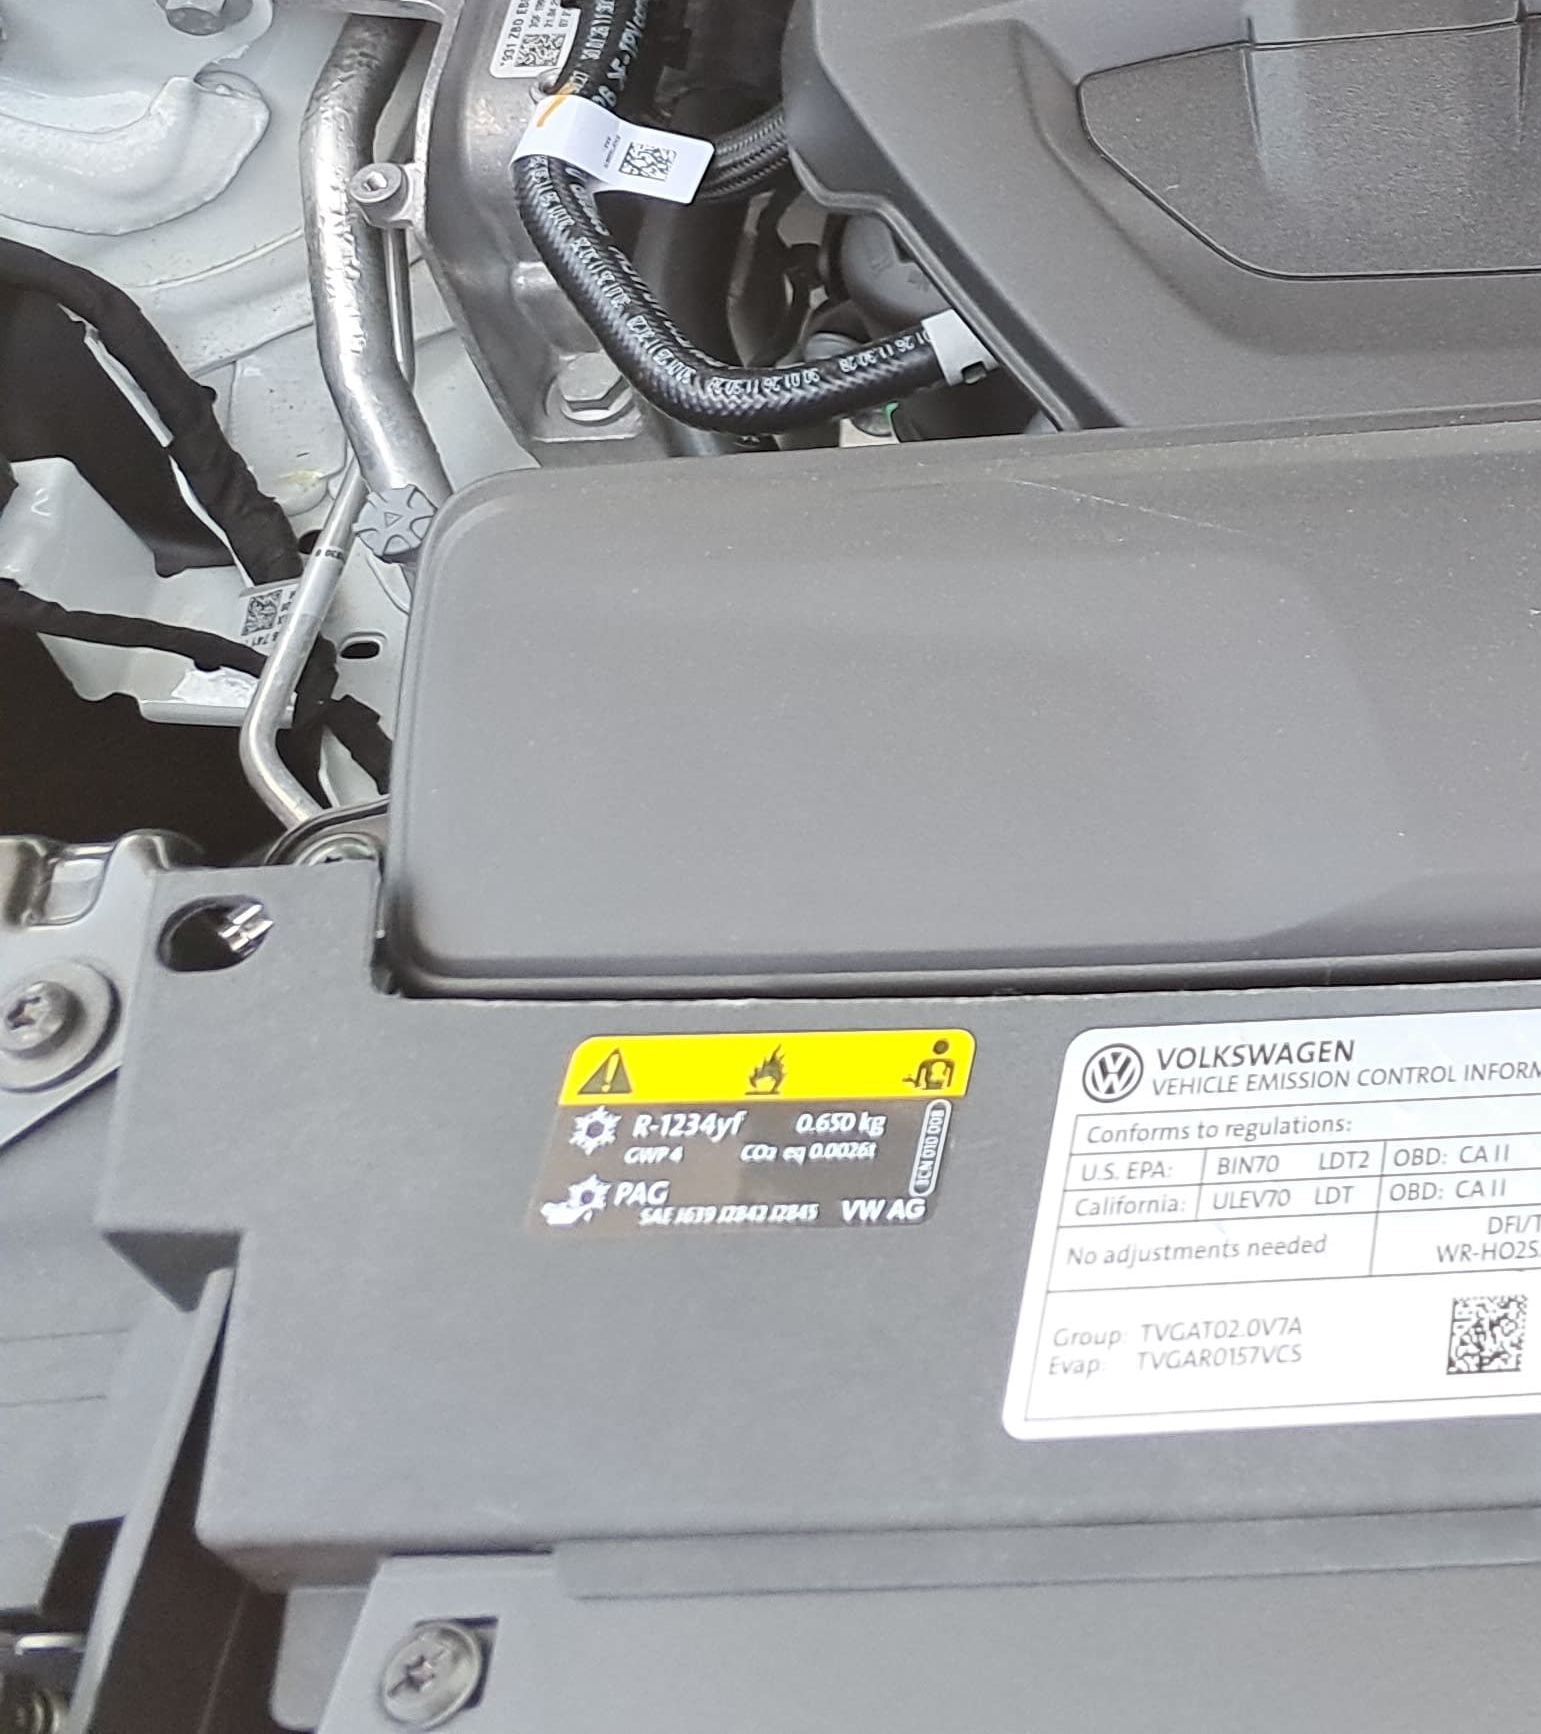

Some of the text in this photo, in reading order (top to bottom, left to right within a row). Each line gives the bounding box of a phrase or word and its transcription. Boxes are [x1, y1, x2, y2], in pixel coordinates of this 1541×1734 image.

[1157, 1040, 1355, 1070] VOLKSWAGEN
[1152, 1074, 1240, 1096] VEHICLE
[1246, 1070, 1349, 1092] EMISSION
[1357, 1067, 1456, 1087] CONTROL
[632, 1110, 887, 1143] R-1234yf 0.650 kg
[1087, 1116, 1352, 1144] Conforms to regulations:
[624, 1146, 670, 1164] GWP
[669, 1146, 685, 1163] 4
[783, 1146, 806, 1165] eq
[1217, 1150, 1370, 1176] BIN70 LDT2
[1393, 1147, 1447, 1167] OBD:
[1459, 1144, 1488, 1163] CA
[1080, 1159, 1173, 1182] U.S. EPA:
[613, 1180, 671, 1207] PAG
[1212, 1186, 1356, 1211] ULEV70 LDT
[1389, 1182, 1443, 1202] OBD:
[1455, 1179, 1484, 1198] CA
[638, 1205, 676, 1226] SAE
[841, 1198, 927, 1223] VW AG
[1075, 1196, 1185, 1219] California:
[1067, 1233, 1327, 1269] No adjustments needed
[1054, 1326, 1126, 1350] Group:
